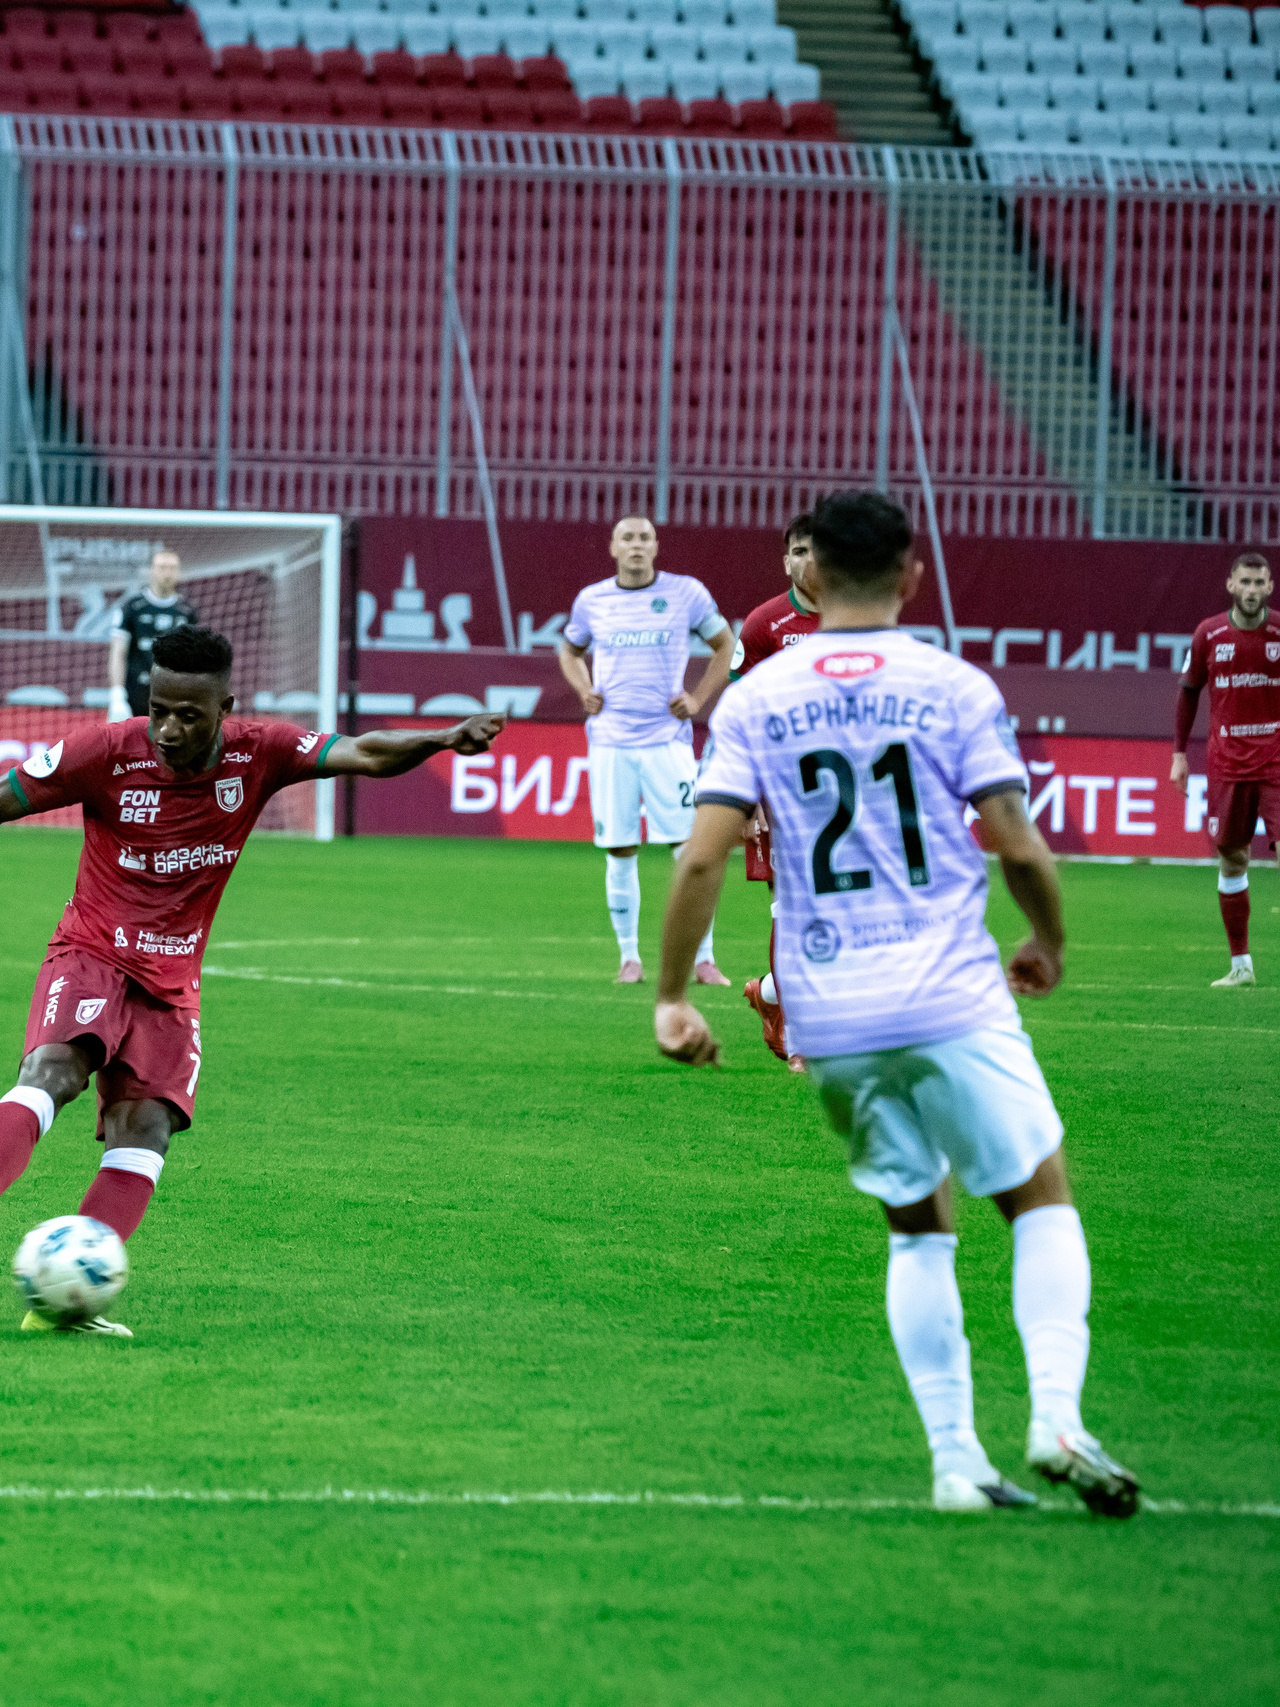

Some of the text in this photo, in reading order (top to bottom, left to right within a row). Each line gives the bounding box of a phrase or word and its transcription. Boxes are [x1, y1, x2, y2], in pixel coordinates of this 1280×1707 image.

[764, 694, 937, 743] ФЕРНАНДЕС
[126, 760, 158, 771] НКНХ
[119, 790, 161, 806] FON
[120, 807, 161, 823] BET
[798, 740, 930, 896] 21
[153, 844, 224, 862] КАЗАНЬ
